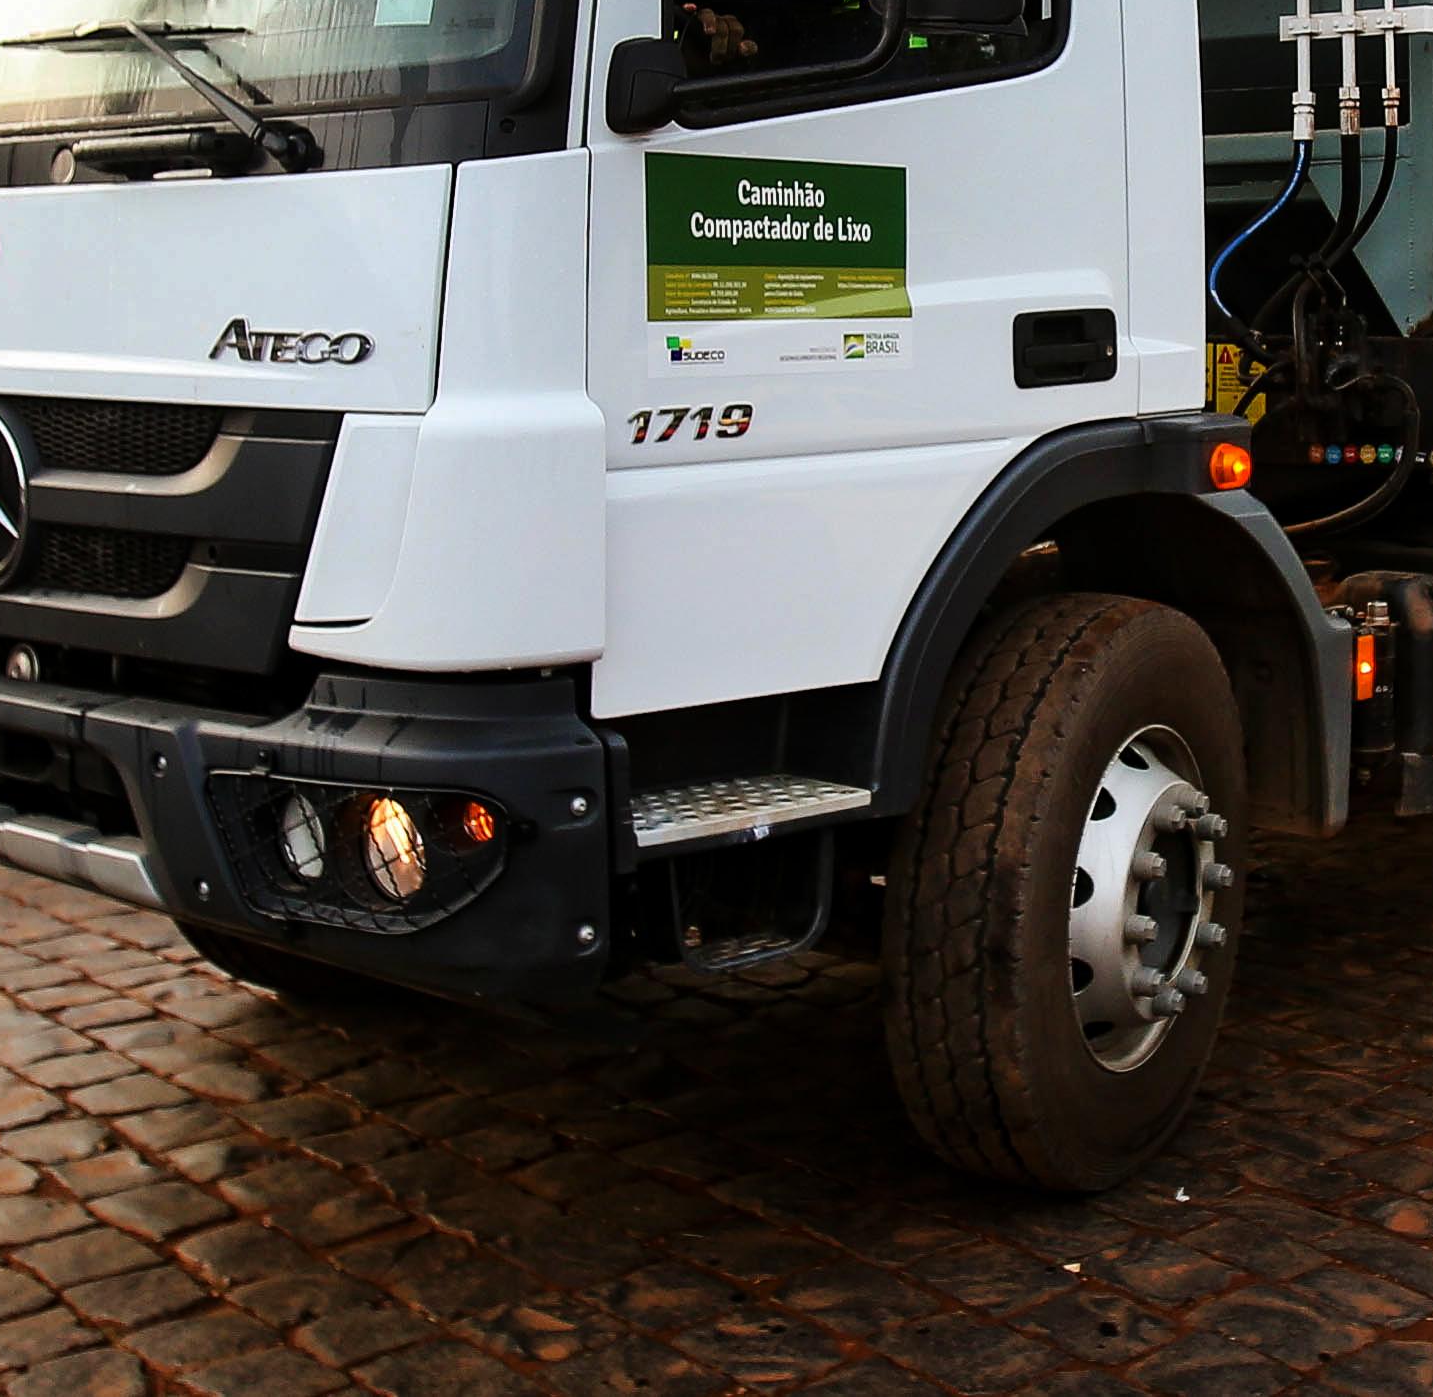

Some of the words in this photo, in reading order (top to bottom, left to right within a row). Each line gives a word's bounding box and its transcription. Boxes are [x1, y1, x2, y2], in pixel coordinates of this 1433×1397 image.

[738, 179, 825, 208] Caminhão
[690, 211, 810, 246] Compactador
[813, 215, 834, 241] de
[837, 216, 872, 242] Lixo
[865, 341, 900, 354] BRASIL
[627, 403, 754, 445] 1719
